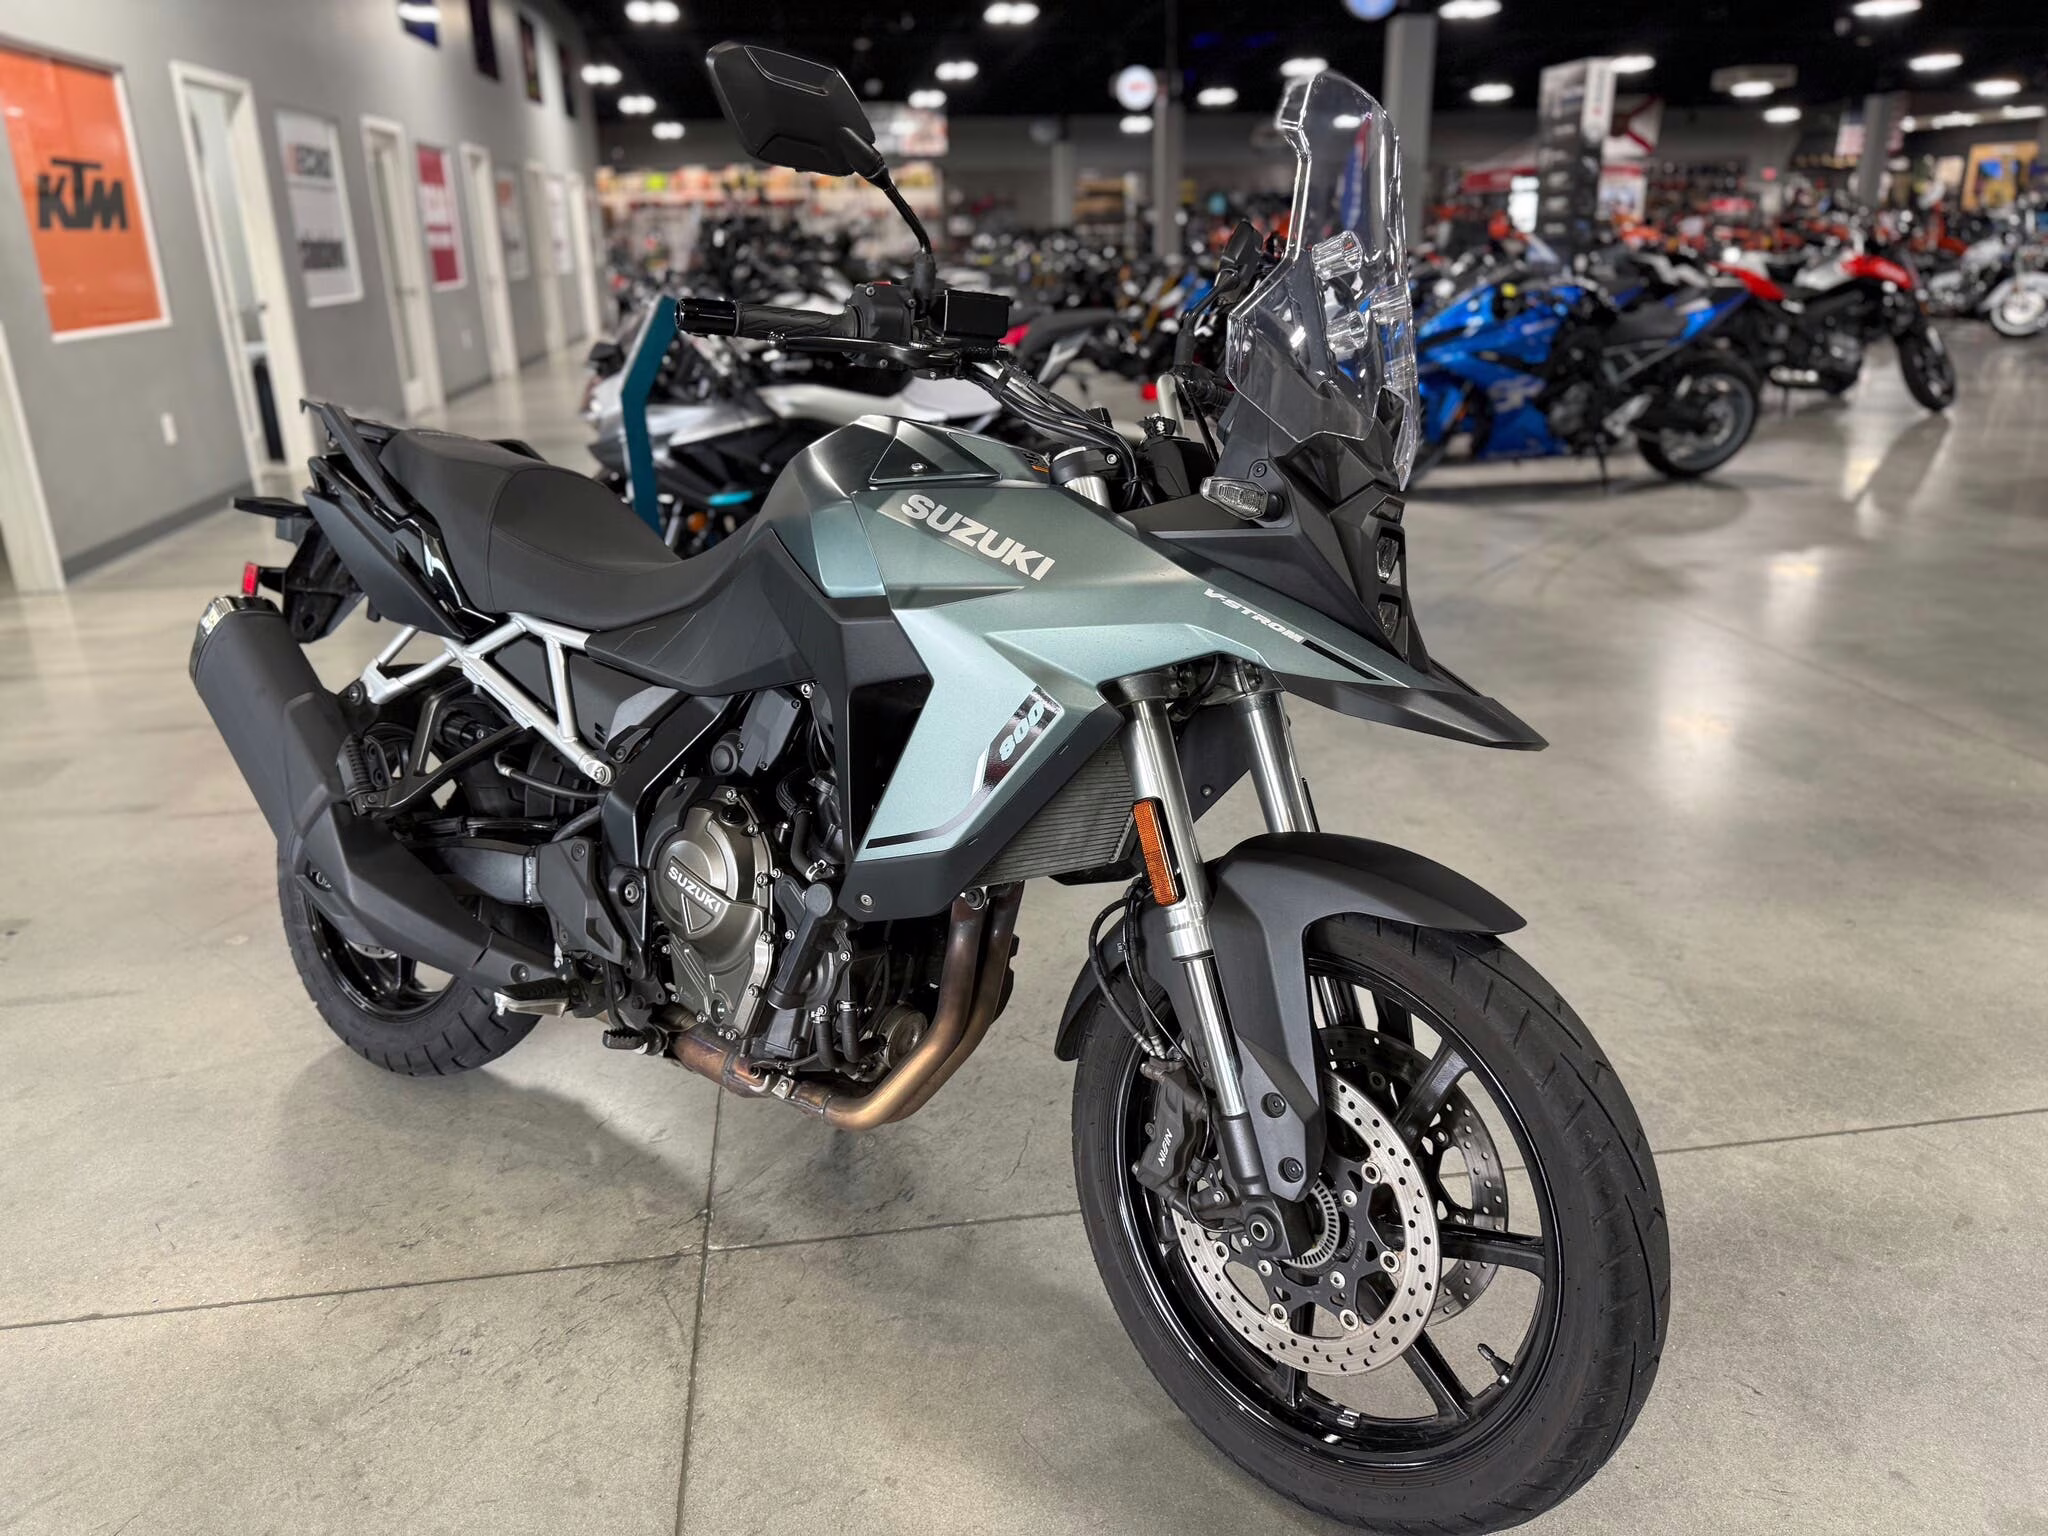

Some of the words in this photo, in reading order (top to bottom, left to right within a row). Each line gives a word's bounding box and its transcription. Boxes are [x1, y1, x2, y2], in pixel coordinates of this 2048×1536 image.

[37, 158, 127, 229] KTM
[901, 494, 1056, 581] SUZUKI
[1203, 588, 1305, 643] V-STROM
[999, 700, 1045, 762] 800
[668, 866, 721, 913] SUZUKI
